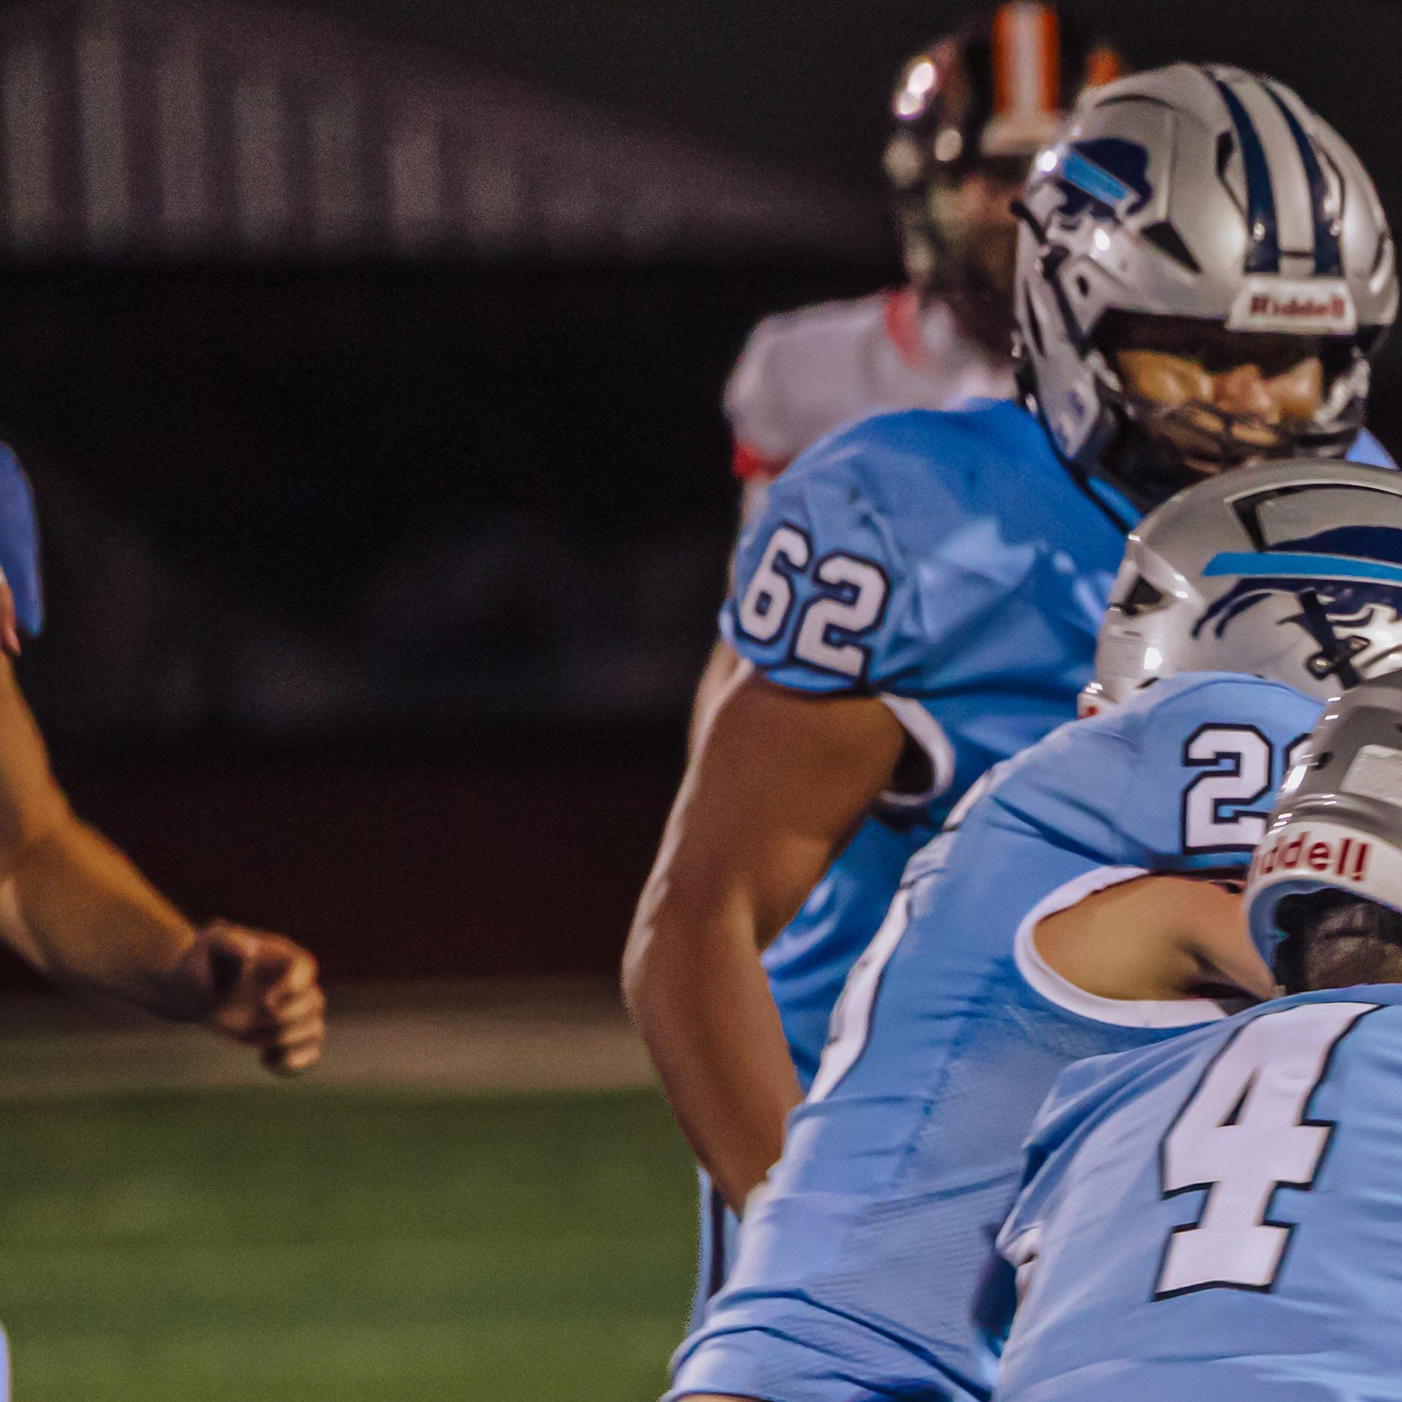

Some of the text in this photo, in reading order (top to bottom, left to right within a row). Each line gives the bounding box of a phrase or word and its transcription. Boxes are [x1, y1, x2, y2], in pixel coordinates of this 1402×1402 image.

[736, 520, 890, 681] 62
[1181, 722, 1311, 855] 2
[1152, 1001, 1387, 1303] 4
